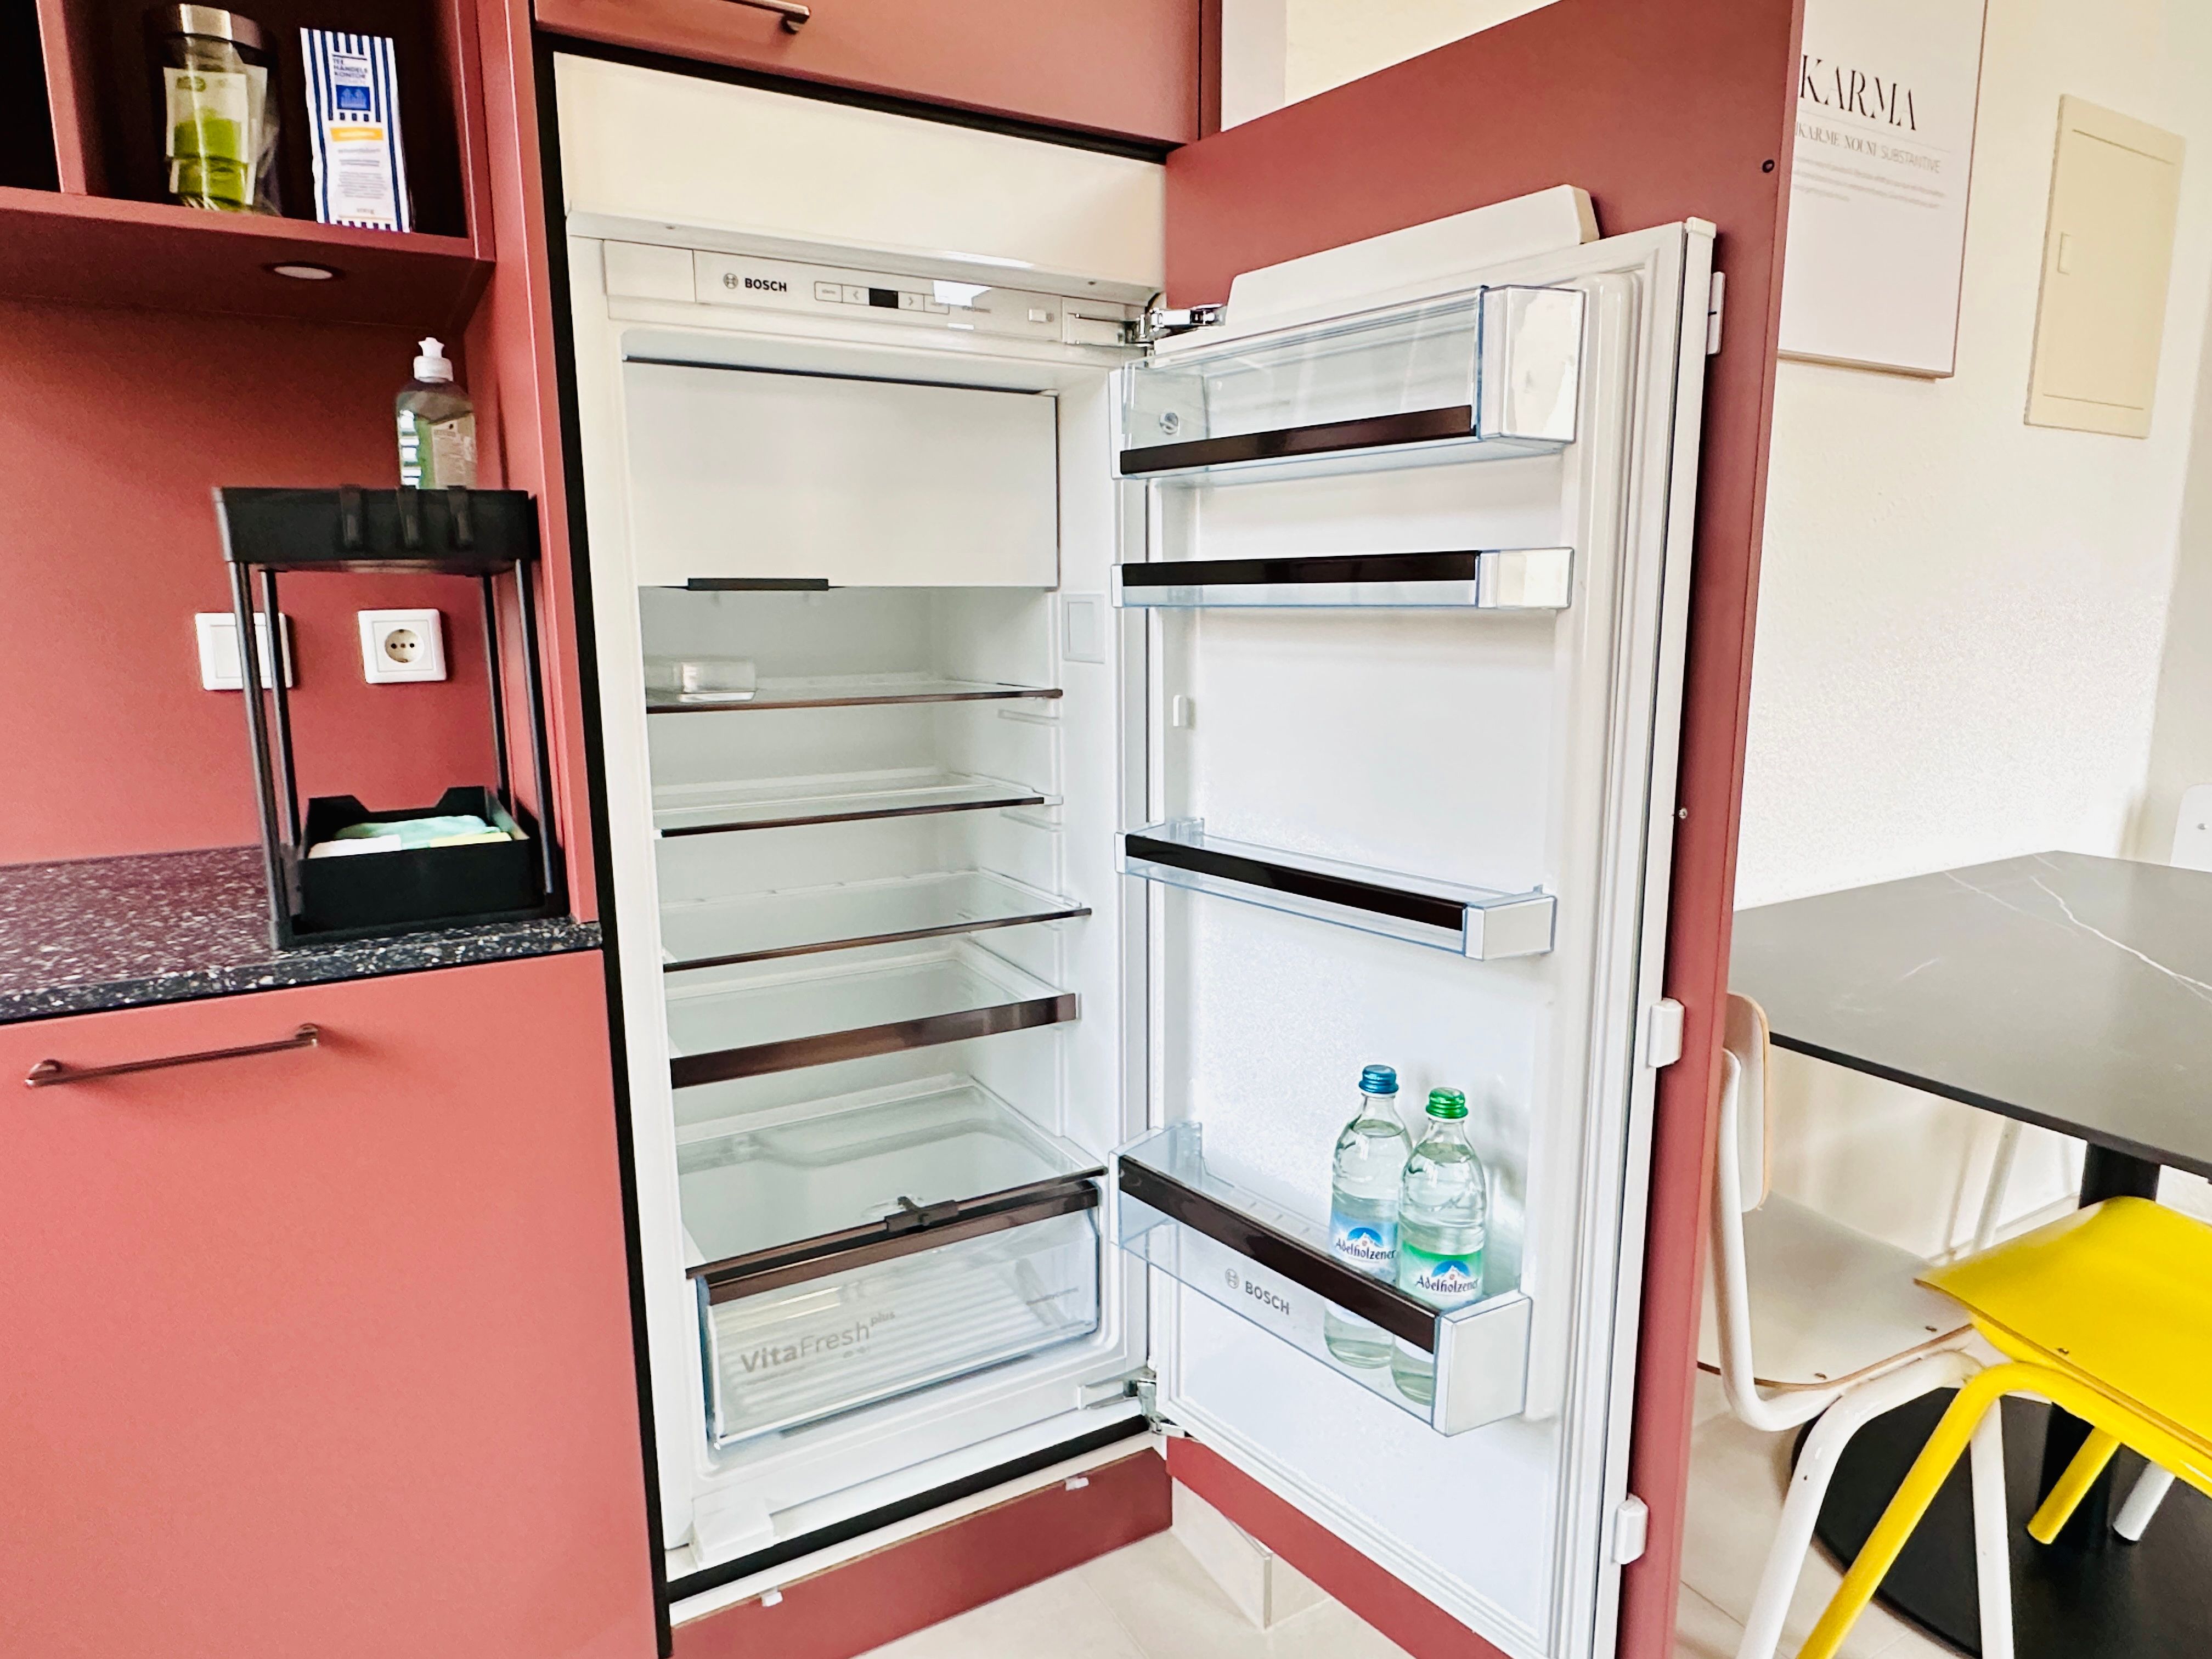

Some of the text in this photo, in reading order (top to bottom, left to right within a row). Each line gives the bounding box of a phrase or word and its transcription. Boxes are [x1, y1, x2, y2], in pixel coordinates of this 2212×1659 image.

[1800, 54, 1916, 131] KARMA
[745, 278, 787, 292] BOSCH
[1335, 1238, 1397, 1260] Adelholzener
[1414, 1274, 1479, 1293] Adelholzener
[1245, 1280, 1289, 1316] BOSCH
